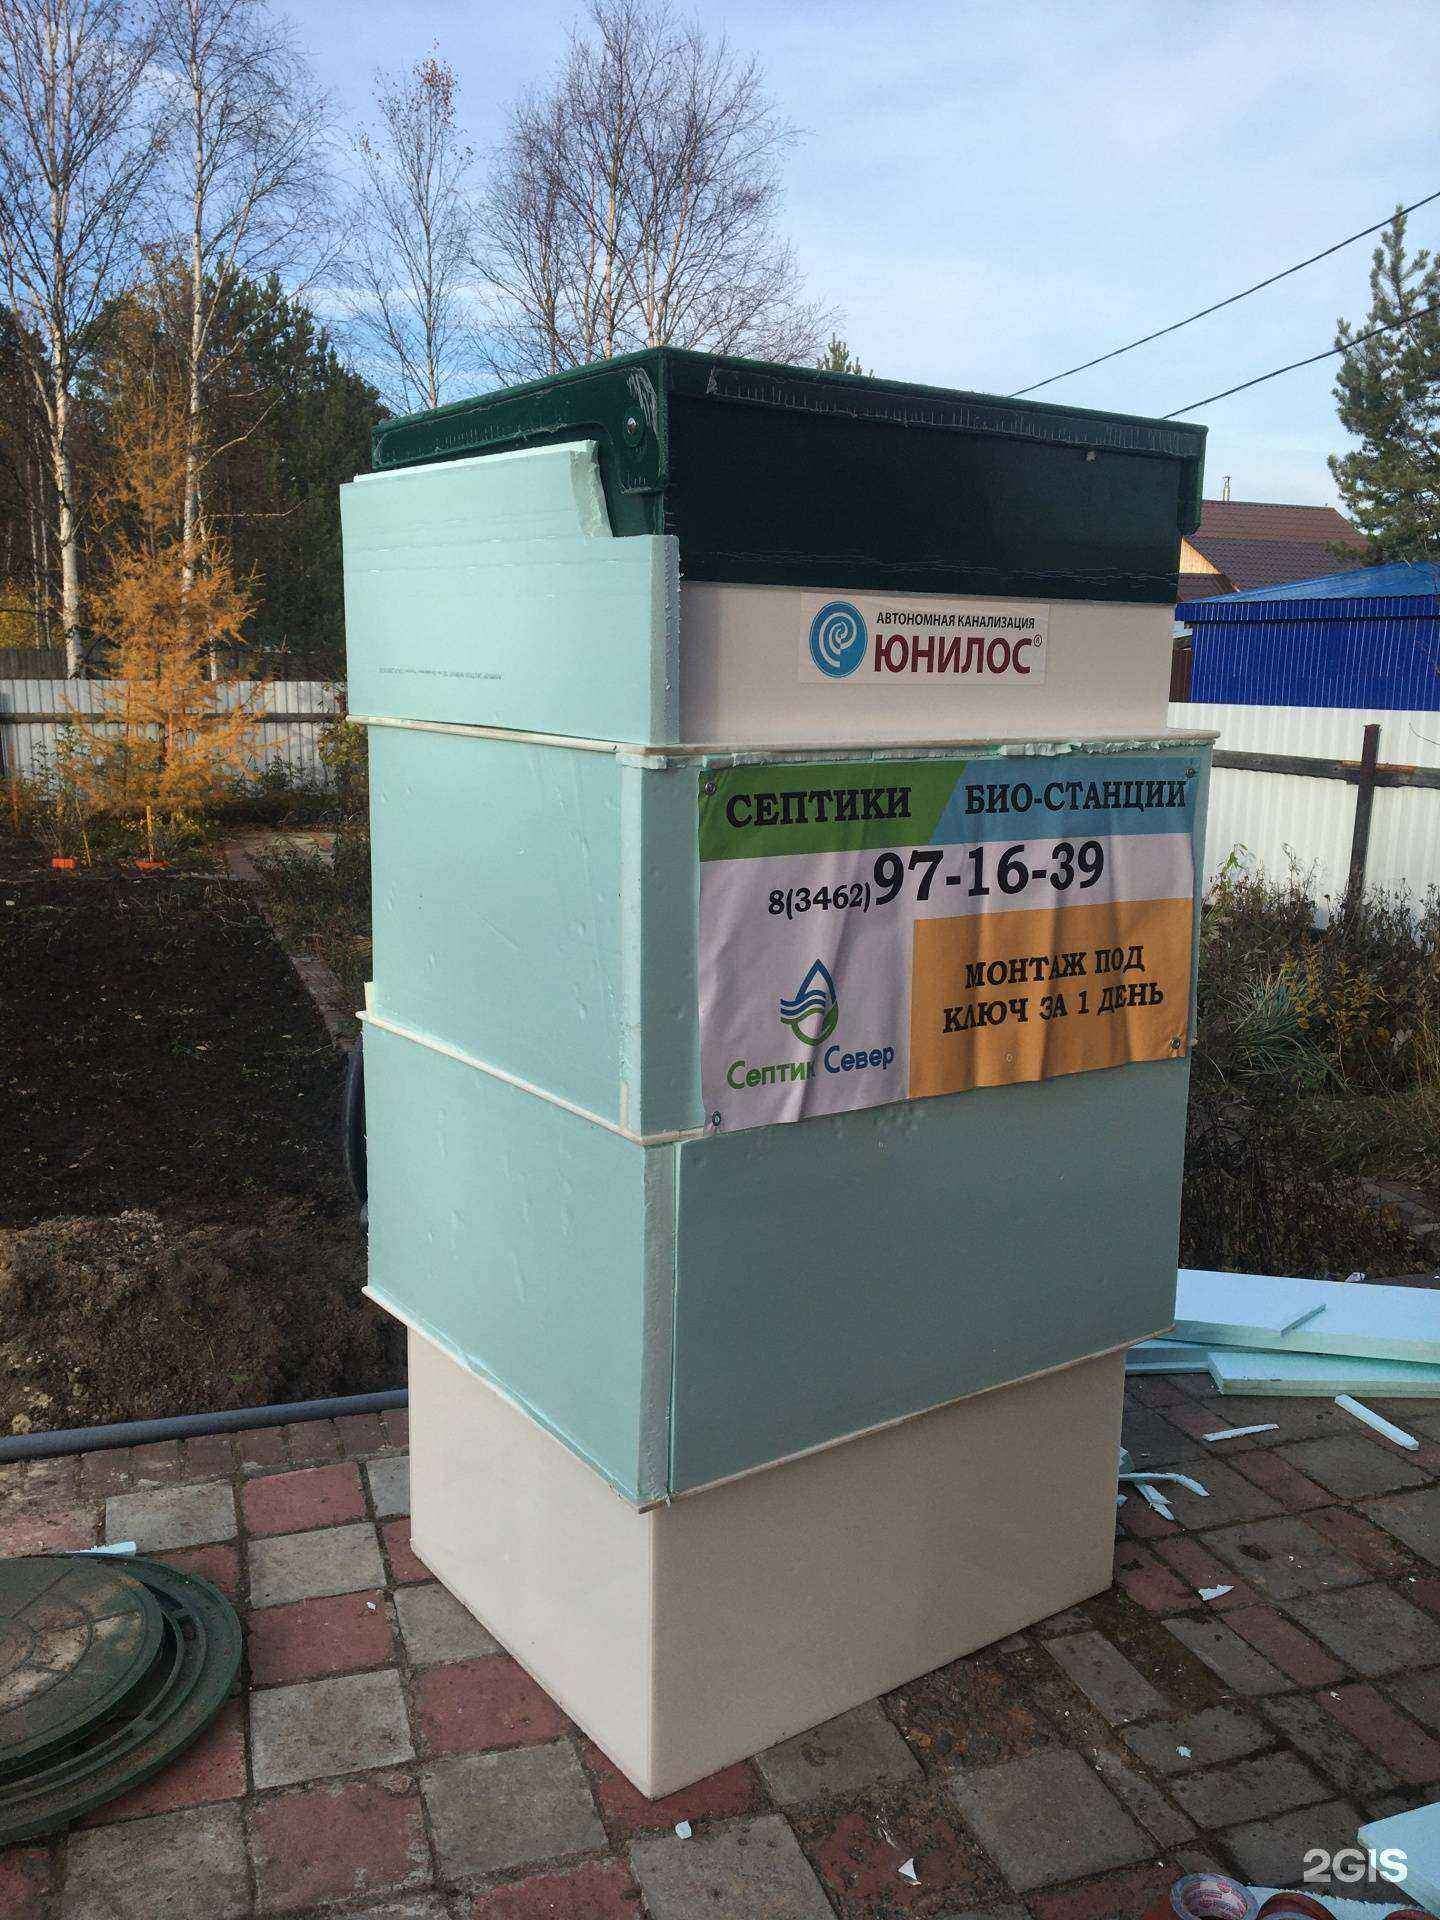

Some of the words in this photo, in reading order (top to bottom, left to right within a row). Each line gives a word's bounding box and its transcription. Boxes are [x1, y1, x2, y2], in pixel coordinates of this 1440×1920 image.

[876, 612, 955, 627] АВТОНОМНАЯ
[956, 614, 1035, 630] КАНАЛИЗАЦИЯ
[726, 787, 912, 828] СЕПТИКИ
[965, 780, 1187, 815] БИО-СТАНЦИИ
[965, 954, 1087, 989] МОНТАЖ
[1095, 945, 1145, 974] ПОД
[942, 1003, 1029, 1034] КЛЮЧ
[1039, 993, 1068, 1021] ЗА
[1077, 991, 1089, 1015] 1
[1097, 982, 1164, 1014] ДЕНЬ
[726, 1060, 816, 1090] Септик
[823, 1045, 895, 1074] Север
